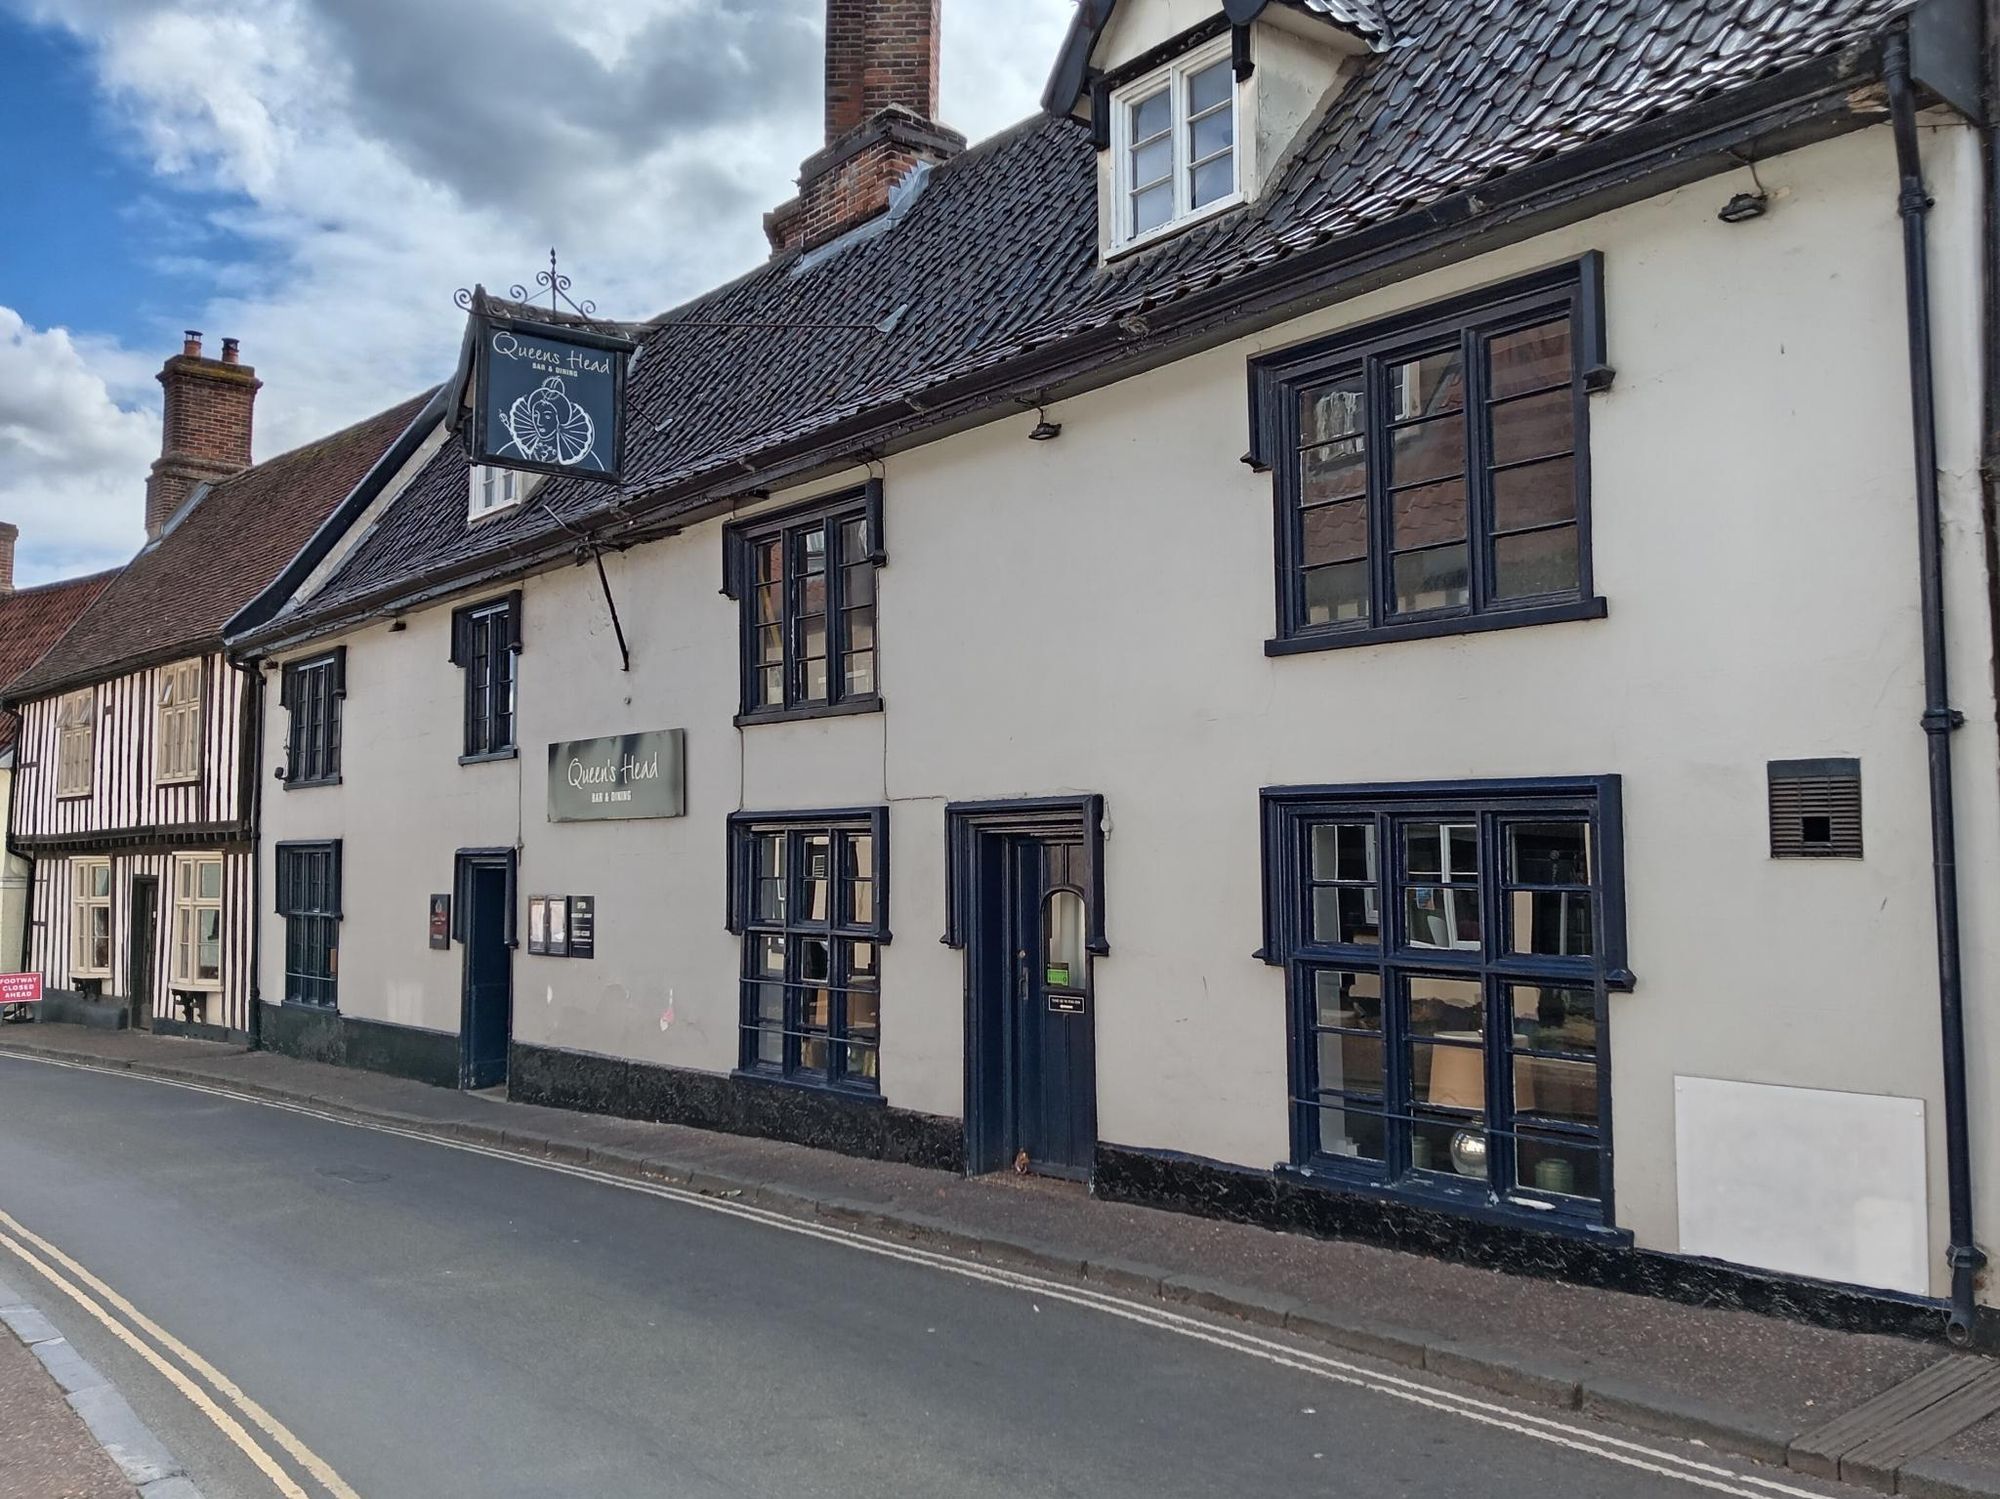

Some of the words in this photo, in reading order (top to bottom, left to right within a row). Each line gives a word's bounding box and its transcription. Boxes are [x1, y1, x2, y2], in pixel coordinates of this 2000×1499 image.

[493, 331, 560, 364] Queens
[566, 350, 610, 375] Head
[532, 362, 546, 371] BAR
[555, 366, 578, 377] DINING
[568, 757, 617, 789] Queen's
[620, 751, 659, 784] Head
[591, 792, 603, 803] BAR
[610, 790, 632, 801] DINING
